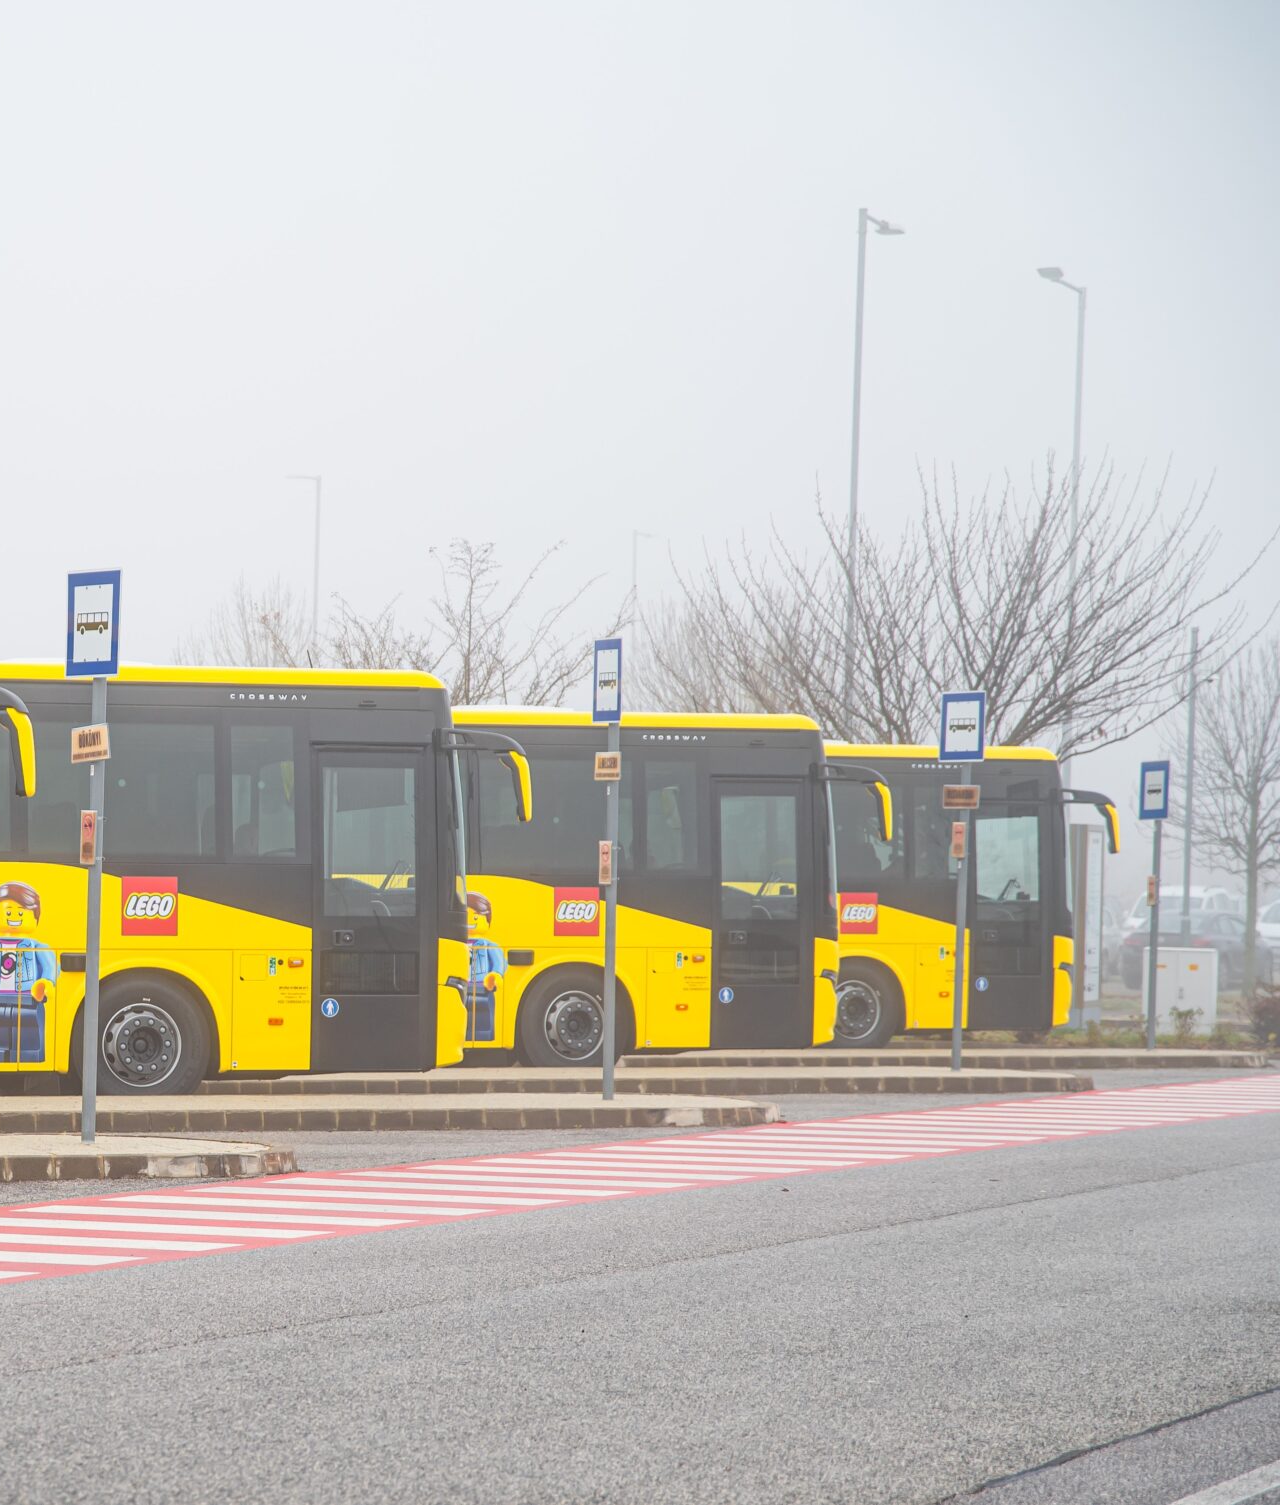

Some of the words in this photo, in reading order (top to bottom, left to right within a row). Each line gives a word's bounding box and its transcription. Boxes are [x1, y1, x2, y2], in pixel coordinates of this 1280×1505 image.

[229, 693, 307, 701] CROSSWAY
[125, 893, 175, 918] LEGO
[556, 901, 597, 921] LEGO
[842, 905, 876, 922] LEGO
